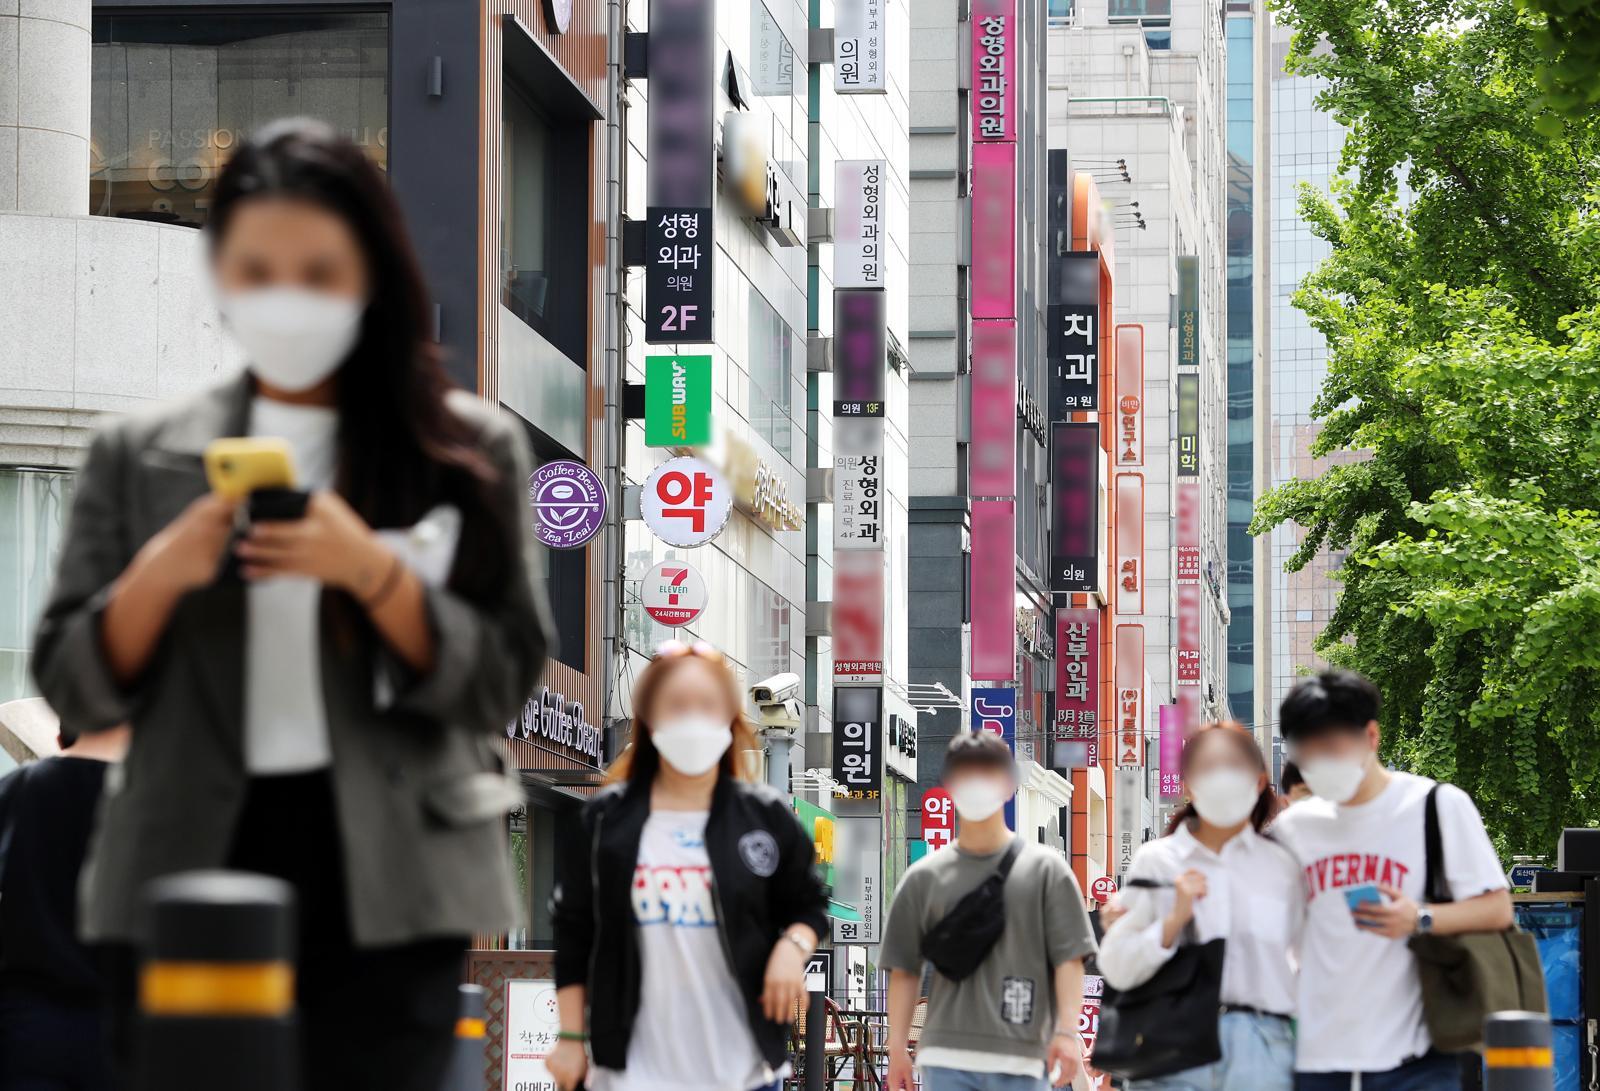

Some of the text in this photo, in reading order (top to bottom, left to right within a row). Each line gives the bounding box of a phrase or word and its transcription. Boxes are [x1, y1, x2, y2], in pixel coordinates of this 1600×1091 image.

[840, 38, 860, 84] 의원
[868, 36, 878, 83] 성형외과
[979, 15, 1007, 138] 성형외과의원
[658, 213, 699, 239] 성형
[861, 164, 879, 282] 성형외과의원
[657, 244, 702, 270] 외과
[666, 275, 693, 292] 의원
[661, 305, 698, 331] 2F
[1064, 313, 1096, 385] 치과
[1182, 311, 1195, 363] 성형외과
[671, 360, 687, 440] SUBWAY
[841, 403, 879, 414] 의원 13F
[1065, 396, 1092, 407] 의원
[837, 457, 857, 470] 의원
[1181, 435, 1196, 470] 미학
[538, 463, 575, 482] Coffee
[576, 468, 598, 502] Bean
[857, 455, 880, 543] 성형외과
[656, 471, 713, 533] 약
[842, 479, 854, 528] 진료과목
[542, 527, 562, 543] Tea
[563, 518, 592, 542] Leaf
[660, 567, 688, 606] 7
[1063, 563, 1085, 581] 의원
[1121, 559, 1138, 592] 의원
[834, 661, 882, 672] 성형외과의원
[1065, 621, 1091, 702] 산부인과
[541, 686, 573, 747] Coffee
[842, 722, 871, 784] 의원
[1088, 744, 1096, 766] 3F
[866, 790, 879, 800] 3F
[1162, 774, 1180, 784] 성형
[1162, 784, 1181, 795] 외과
[924, 796, 952, 826] 약
